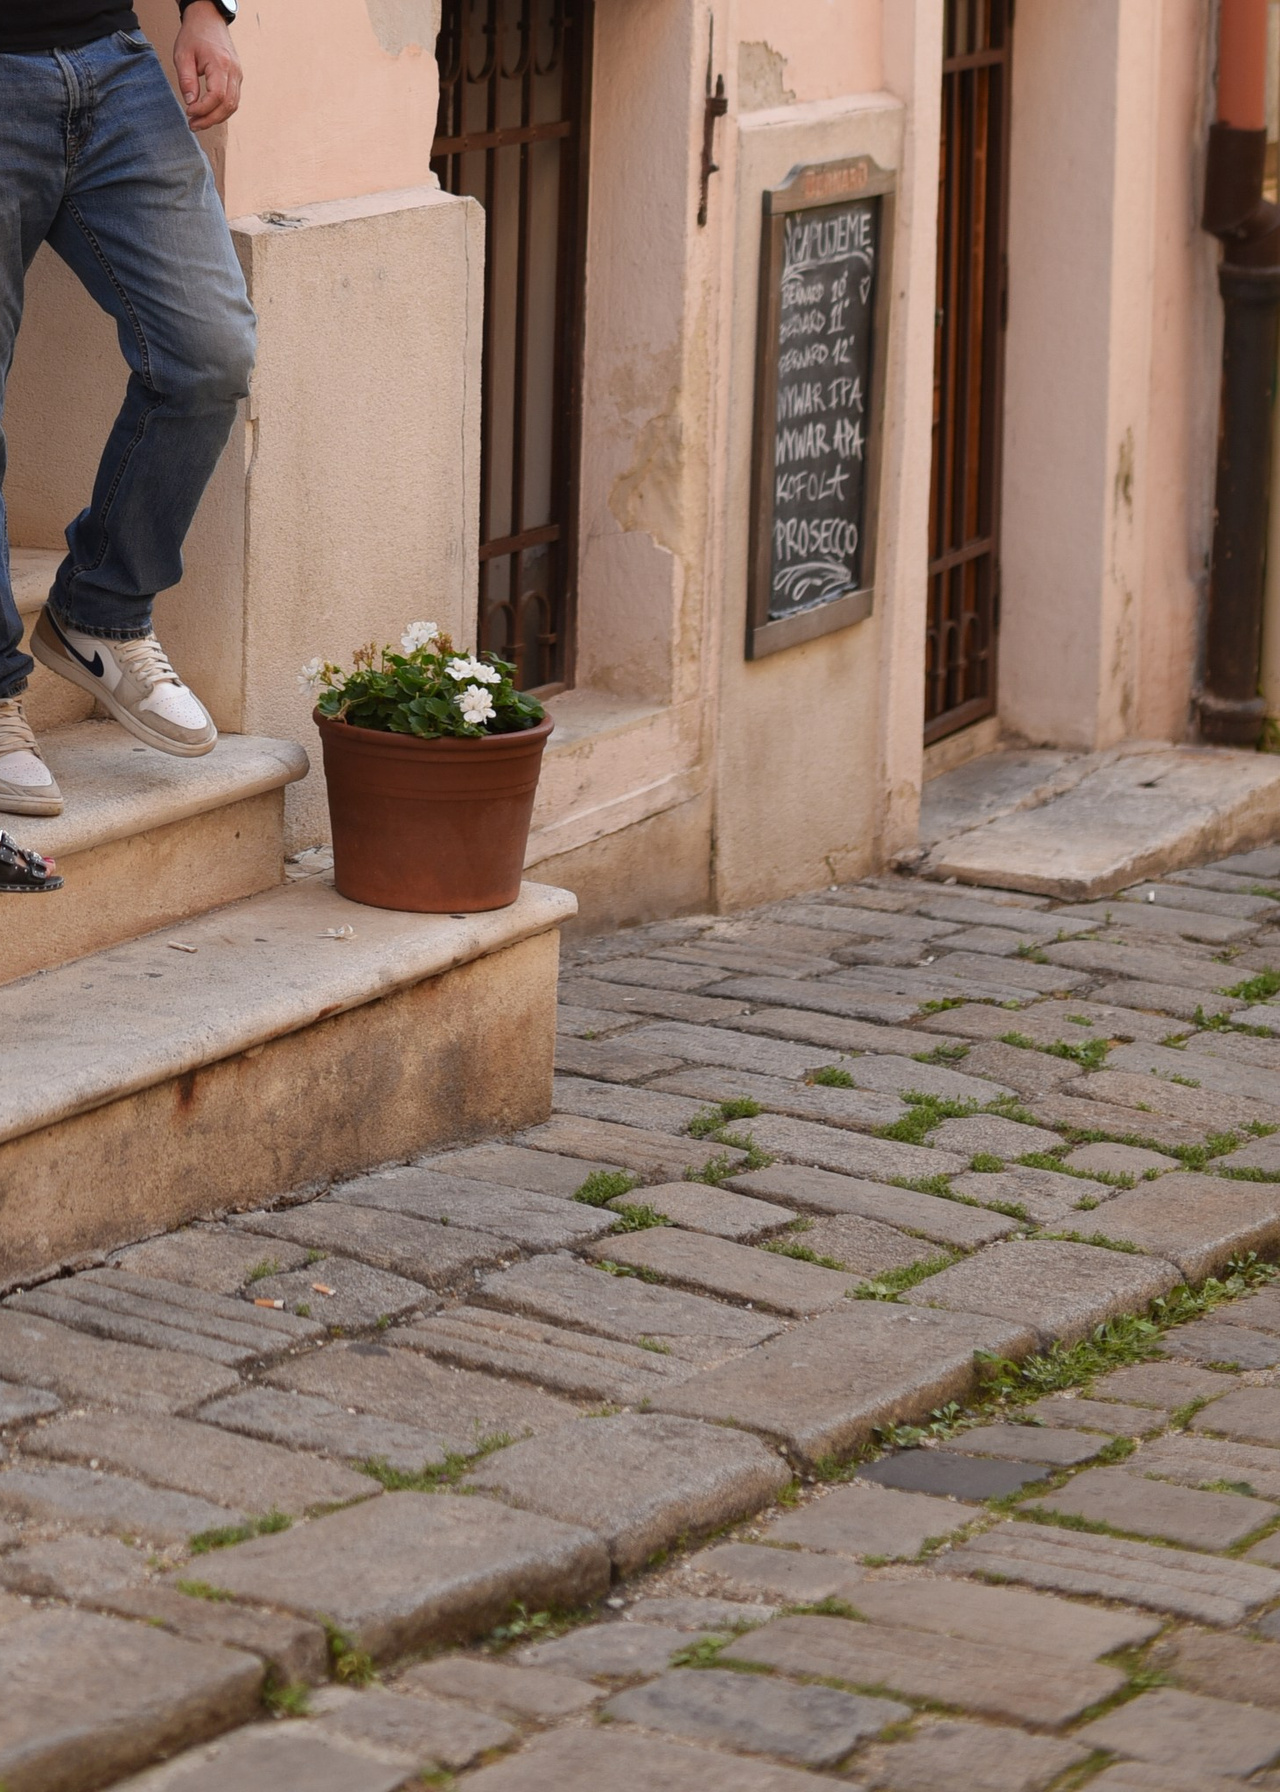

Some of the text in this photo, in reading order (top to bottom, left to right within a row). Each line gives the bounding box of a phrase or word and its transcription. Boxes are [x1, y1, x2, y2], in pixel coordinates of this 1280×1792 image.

[791, 212, 872, 264] ČAPUJEME
[828, 376, 864, 414] IPA
[775, 417, 864, 467] WYWAR APA
[776, 464, 850, 505] KOFOLA
[775, 517, 859, 562] PROSECCO
